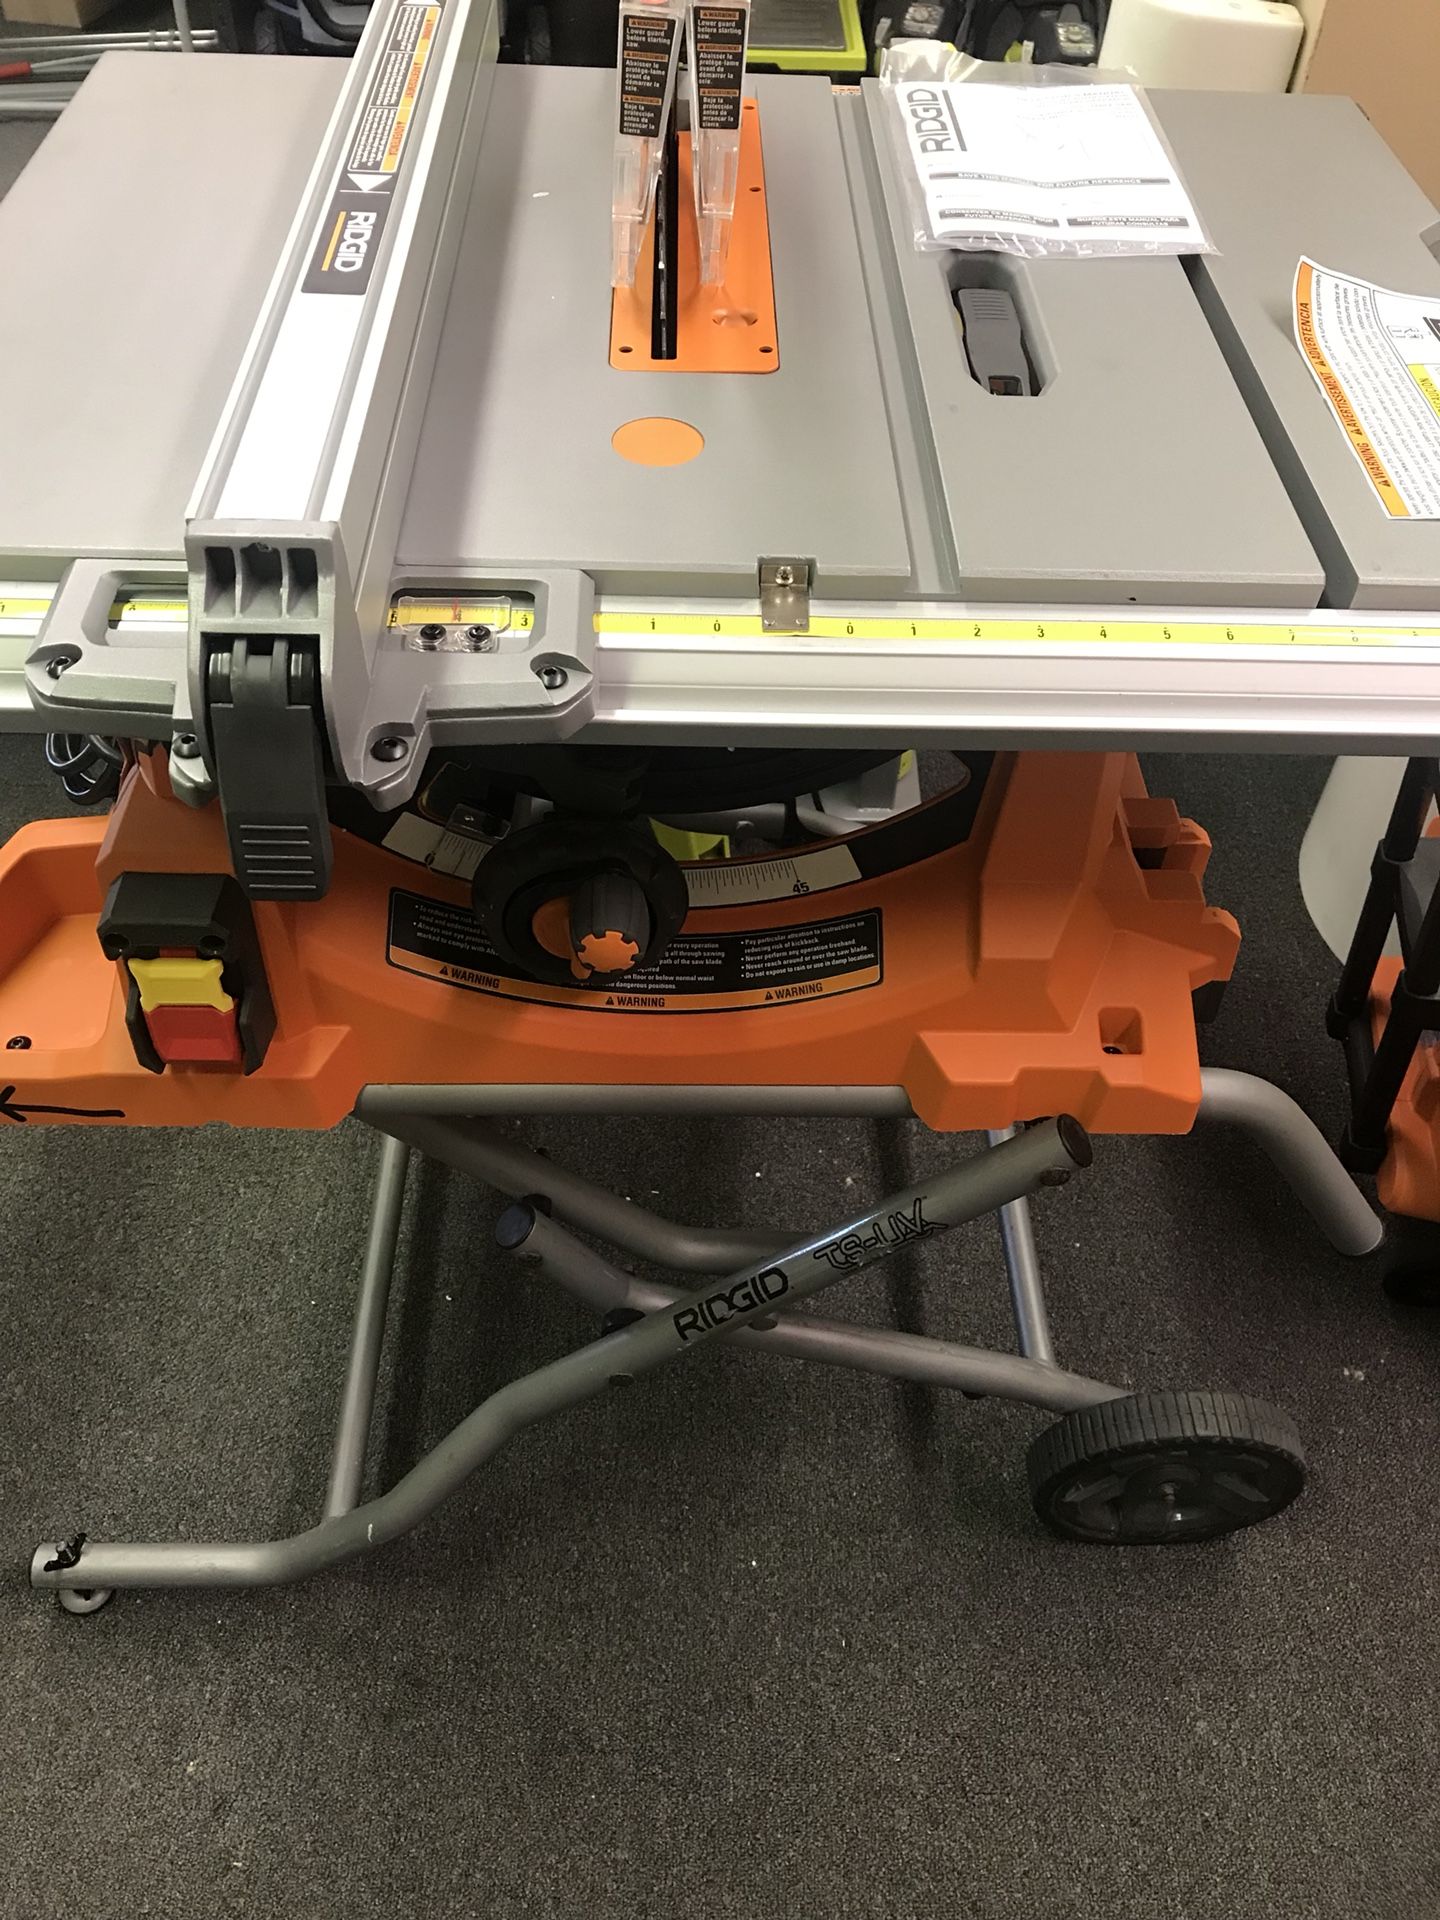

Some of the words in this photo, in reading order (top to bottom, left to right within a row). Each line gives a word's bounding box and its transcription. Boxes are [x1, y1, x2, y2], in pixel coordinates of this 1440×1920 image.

[624, 103, 637, 111] Baje
[907, 89, 954, 153] RIDGID
[958, 172, 979, 180] SAVE
[1056, 180, 1090, 189] FUTURE
[1091, 177, 1141, 186] REFERENCE
[334, 211, 377, 272] RIDGID
[1300, 302, 1321, 361] ADVERTENCIA
[1320, 370, 1358, 428] AVERTISSEMENT
[1357, 442, 1387, 480] WARNING
[521, 617, 528, 627] 3
[650, 619, 656, 630] 1
[713, 620, 721, 632] 0
[846, 623, 854, 635] 0
[911, 626, 917, 636] 1
[974, 627, 982, 637] 2
[1037, 628, 1045, 638] 3
[1100, 629, 1107, 639] 4
[1164, 630, 1171, 640] 5
[1226, 630, 1234, 641] 6
[792, 881, 810, 894] 45
[417, 922, 440, 933] Always
[757, 935, 785, 945] particular
[788, 931, 813, 939] attention
[821, 923, 856, 933] instructions
[417, 932, 440, 942] marked
[448, 940, 469, 950] comply
[765, 952, 787, 960] perform
[800, 945, 828, 954] operation
[829, 939, 855, 948] freehand
[783, 956, 803, 965] around
[451, 967, 500, 989] WARNING
[766, 968, 786, 976] expose
[774, 982, 823, 999] WARNING
[617, 997, 665, 1007] WARNING
[673, 1267, 789, 1341] RIDGID
